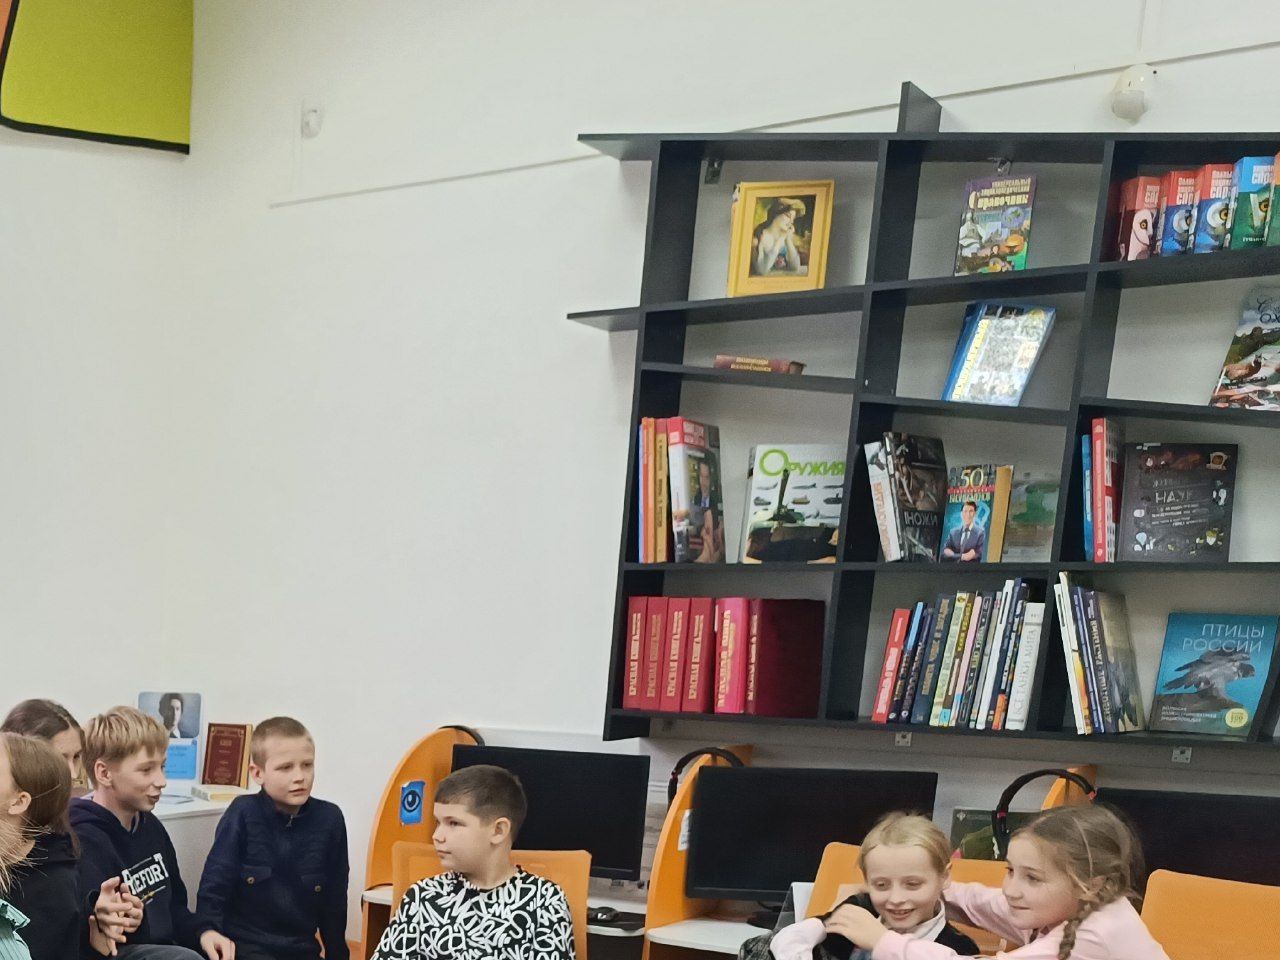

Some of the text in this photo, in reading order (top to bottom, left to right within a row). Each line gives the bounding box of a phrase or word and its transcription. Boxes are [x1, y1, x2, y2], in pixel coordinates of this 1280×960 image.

[960, 469, 984, 488] 50
[1201, 623, 1265, 638] ПТИЦЫ
[1183, 638, 1262, 653] РОССИИ
